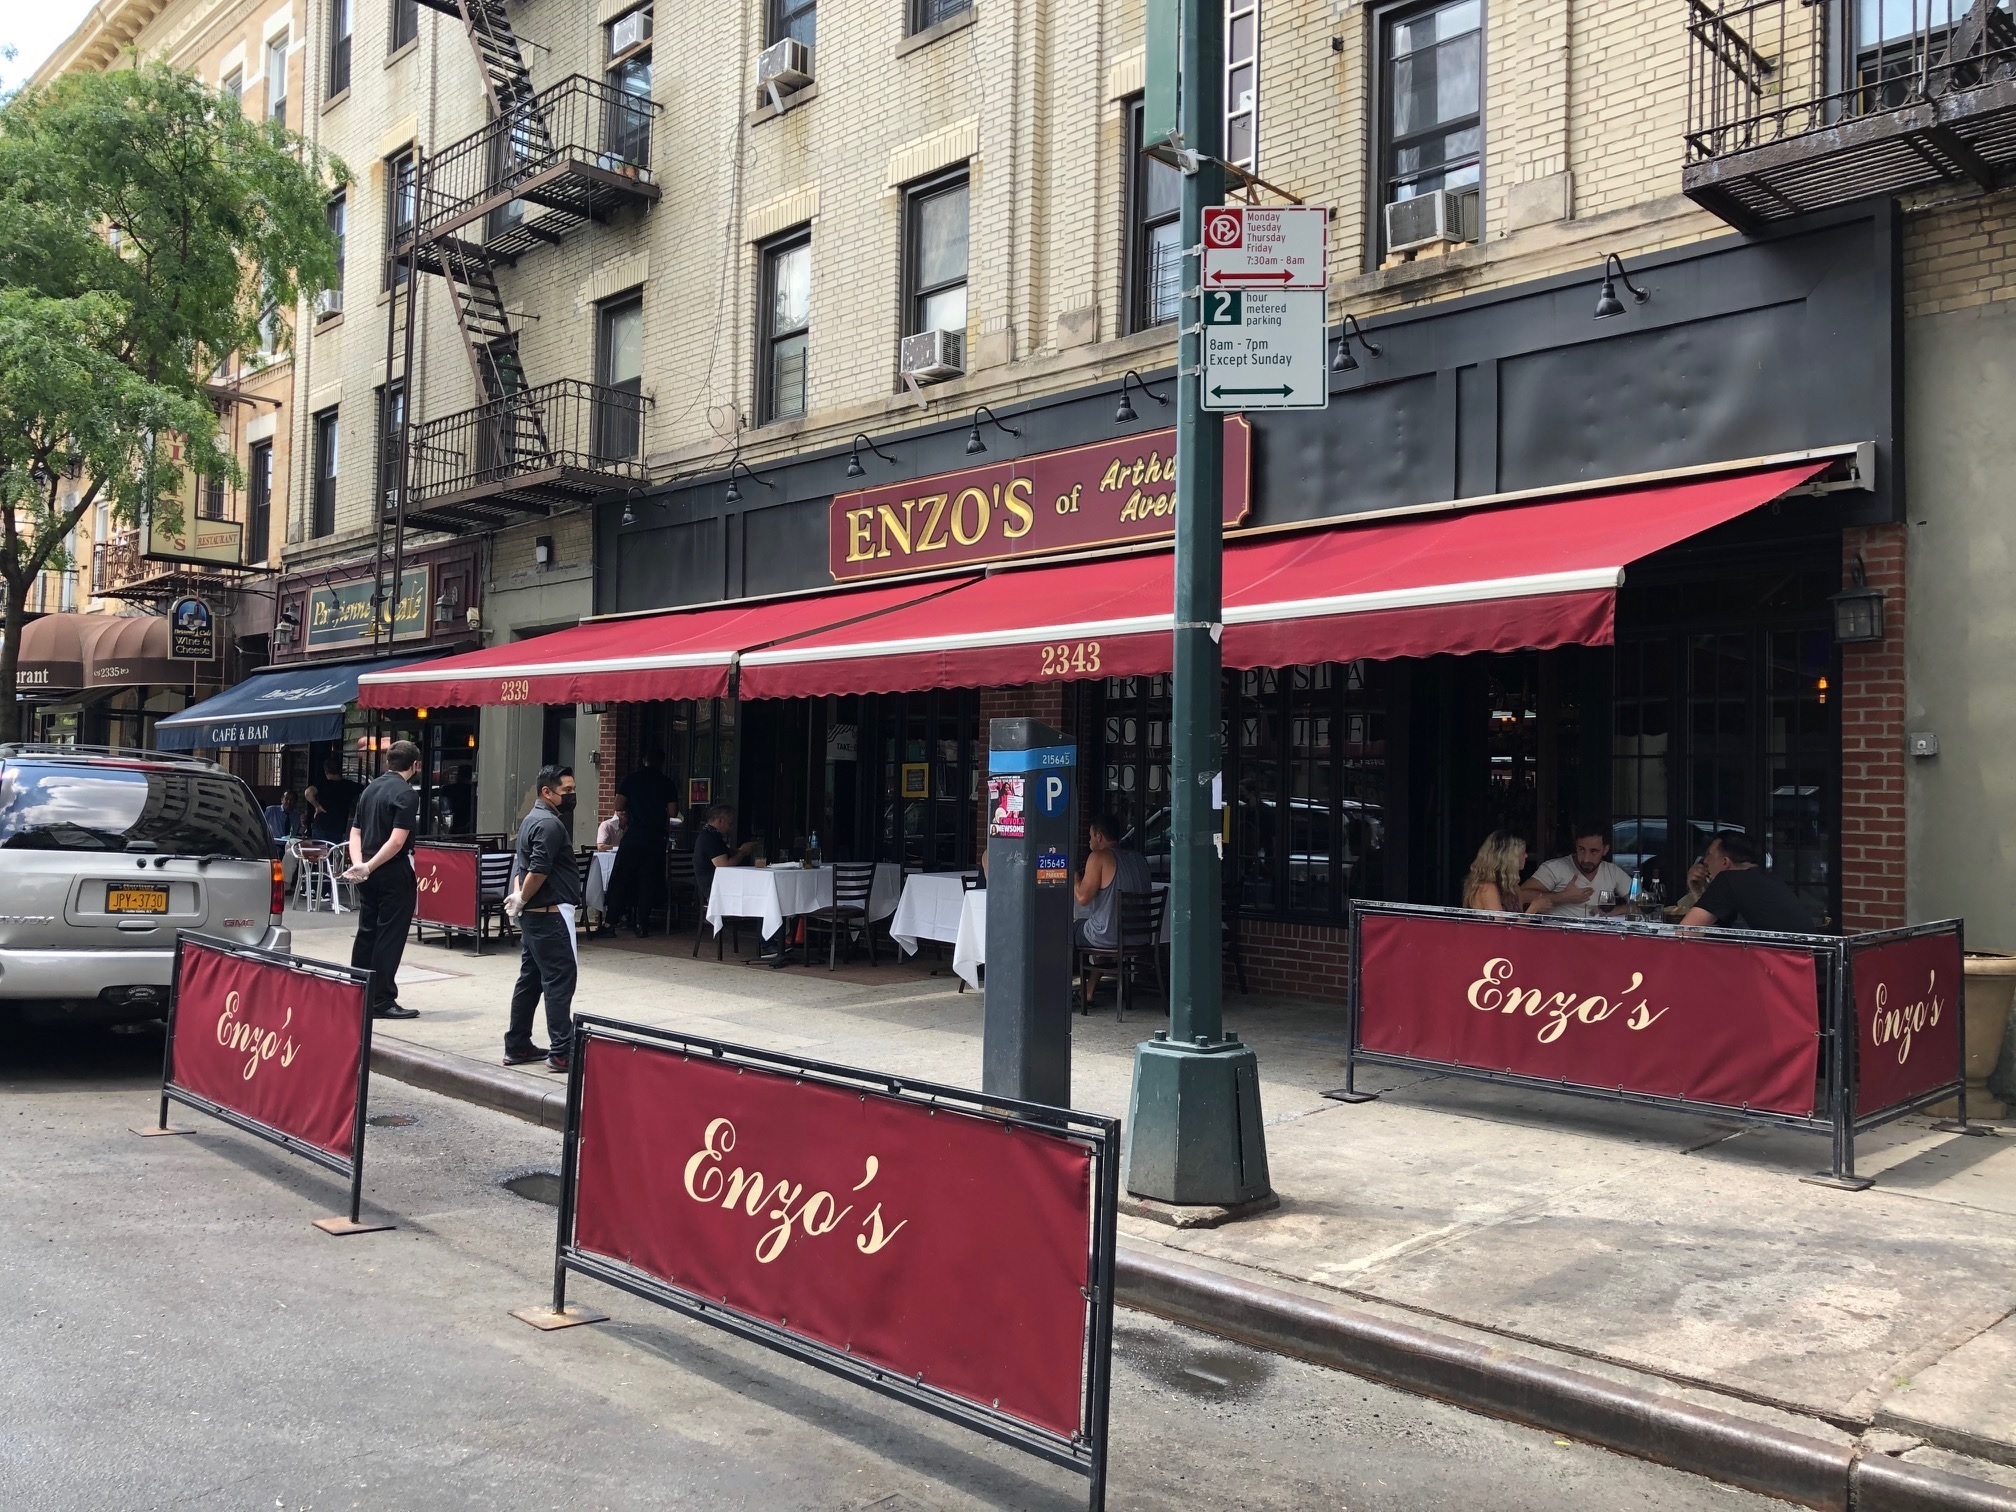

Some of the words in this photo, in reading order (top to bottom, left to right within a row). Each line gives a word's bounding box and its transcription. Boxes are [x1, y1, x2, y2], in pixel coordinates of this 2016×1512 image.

[1246, 212, 1280, 223] Monday
[1246, 223, 1282, 233] Tuesday
[1246, 232, 1286, 243] Thursday
[1246, 243, 1273, 254] Friday
[1246, 256, 1278, 265] 7:30am
[1286, 256, 1305, 265] 8am
[1246, 292, 1268, 302] hour
[1213, 291, 1232, 322] 2
[1246, 303, 1287, 314] metered
[1246, 315, 1282, 327] parking
[1209, 338, 1233, 350] 8am
[1246, 338, 1268, 352] 7pm
[1209, 353, 1248, 367] Except
[1251, 353, 1292, 367] Sunday
[1099, 451, 1177, 492] Arthu
[845, 477, 1034, 563] ENZO'S
[1055, 483, 1083, 515] of
[197, 533, 238, 547] RESTAURANT
[175, 636, 200, 646] Wine
[175, 645, 210, 655] Cheese
[1040, 641, 1101, 676] 2343
[100, 666, 120, 678] 2335
[500, 679, 529, 702] 2339
[212, 723, 237, 743] CAFÉ
[239, 727, 245, 741] &
[248, 724, 269, 740] BAR
[1042, 754, 1070, 765] 215645
[1046, 776, 1063, 811] P
[1039, 859, 1066, 868] 215645
[113, 893, 132, 907] JPY
[138, 893, 163, 908] 3730
[223, 917, 255, 928] GMC
[1467, 957, 1670, 1044] Enzo's
[1872, 969, 1945, 1065] Enzo's
[216, 990, 301, 1081] Enzo's
[683, 1117, 909, 1264] Enzo's
